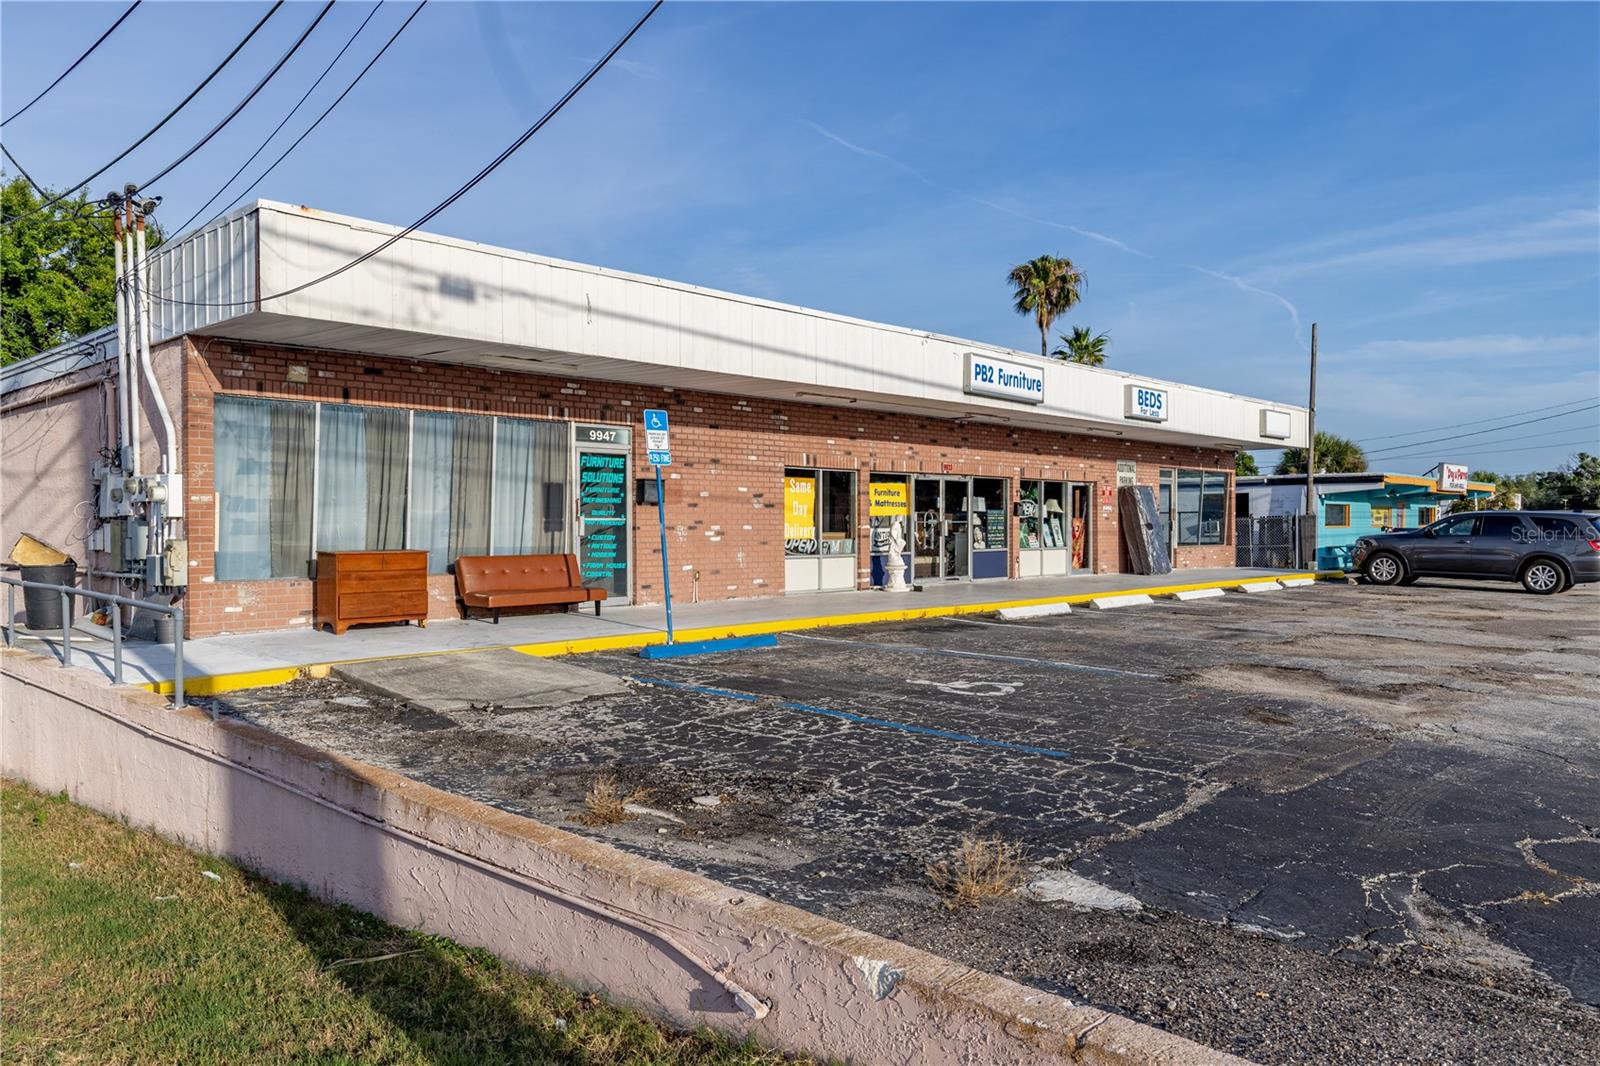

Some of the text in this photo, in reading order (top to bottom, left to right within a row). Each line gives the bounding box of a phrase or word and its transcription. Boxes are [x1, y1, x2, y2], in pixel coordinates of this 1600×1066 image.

[975, 363, 1042, 393] PB2 Furniture
[1137, 389, 1162, 410] BEDS
[1140, 407, 1160, 418] For Less
[589, 430, 616, 441] 9947
[581, 456, 625, 468] FURNITURE
[581, 471, 625, 484] SOLUTIONS
[790, 478, 811, 494] Same
[874, 488, 900, 497] Furniture
[793, 500, 808, 518] Day
[875, 500, 907, 508] Mattresses
[785, 523, 815, 540] Delivery
[785, 539, 814, 554] OPEN
